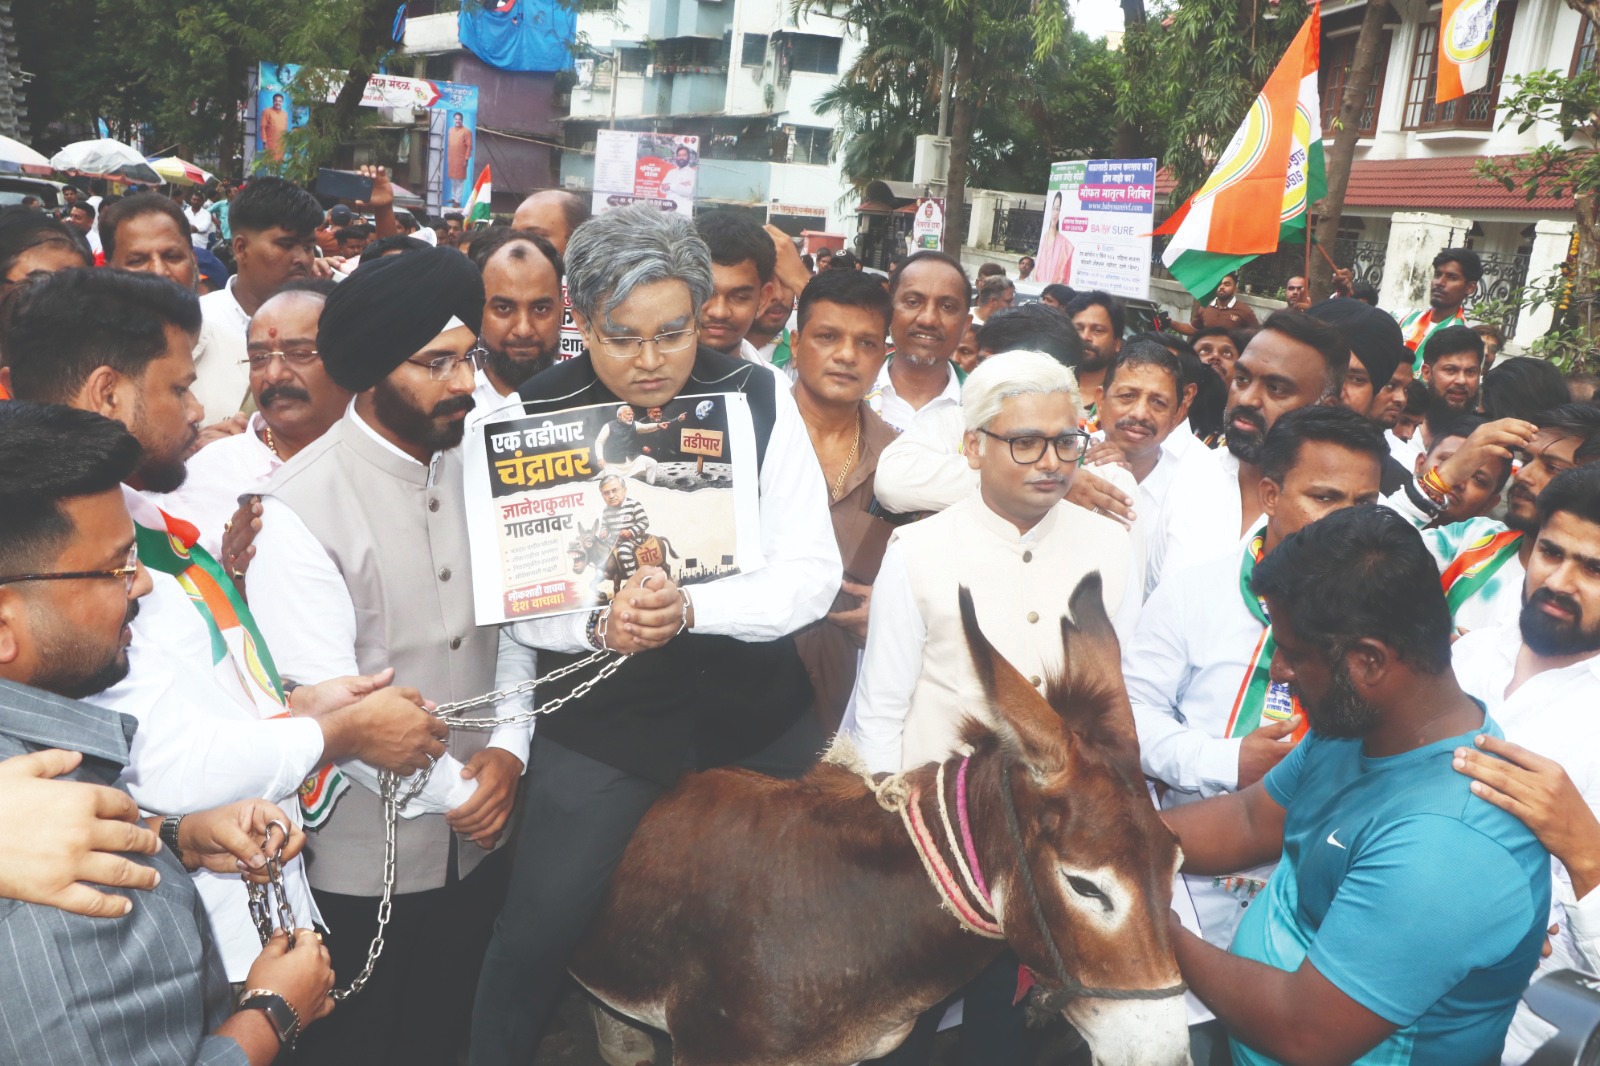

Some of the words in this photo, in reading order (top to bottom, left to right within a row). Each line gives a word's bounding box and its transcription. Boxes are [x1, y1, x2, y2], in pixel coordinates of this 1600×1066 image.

[1080, 185, 1100, 199] मोफत
[1102, 188, 1125, 202] मातृत्व
[1127, 185, 1151, 200] शिबिर
[1111, 225, 1134, 236] SURE
[491, 431, 521, 453] एक
[523, 420, 585, 448] तडीपार
[682, 432, 720, 451] तडीपार
[495, 447, 592, 486] चंद्रावर
[501, 492, 584, 520] ज्ञानेशकुमार
[504, 514, 573, 538] गाढवावर
[638, 547, 659, 563] चोर
[508, 585, 543, 602] लोकशाही
[544, 582, 566, 594] वाचवा
[512, 600, 529, 613] देश
[531, 593, 565, 608] वाचवा!
